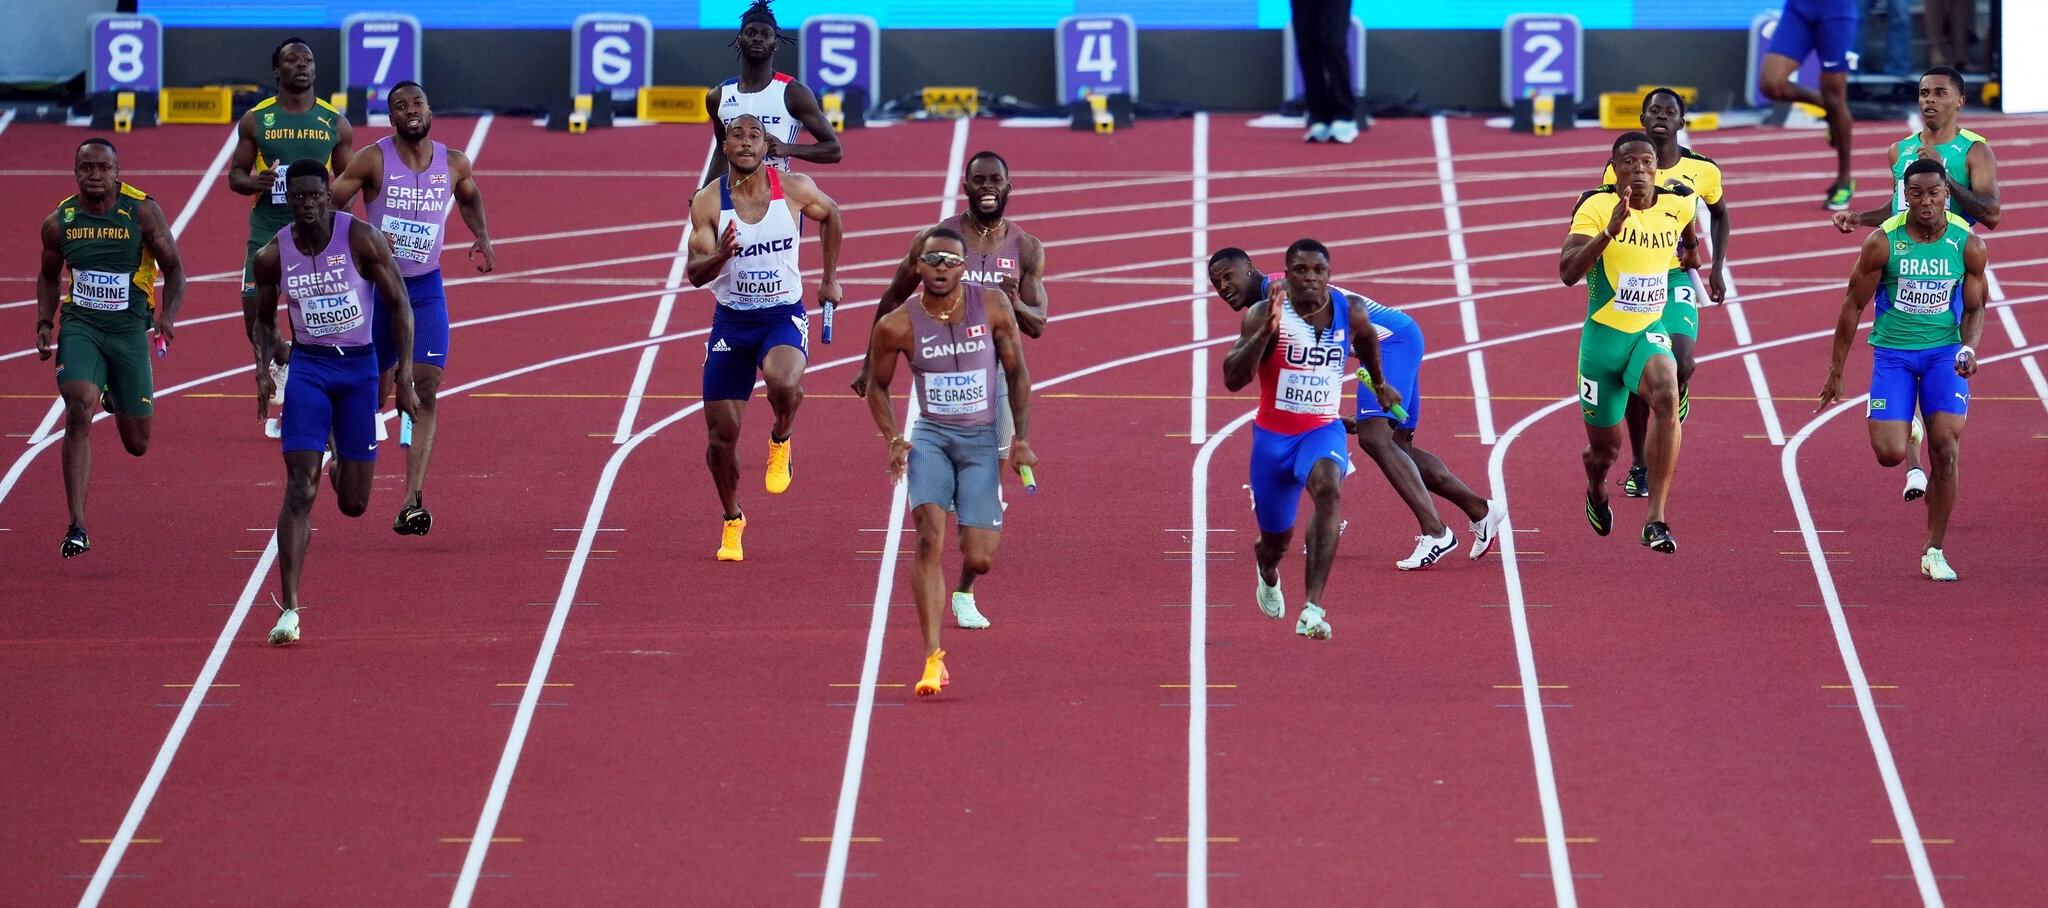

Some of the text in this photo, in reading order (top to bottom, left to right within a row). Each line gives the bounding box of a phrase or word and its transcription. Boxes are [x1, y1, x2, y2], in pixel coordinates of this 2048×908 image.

[107, 33, 144, 83] 8
[362, 36, 399, 84] 7
[592, 35, 632, 85] 6
[818, 37, 858, 86] 5
[1076, 34, 1117, 82] 4
[1523, 34, 1563, 83] 2
[264, 128, 331, 141] SOUTH AFRICA
[387, 185, 445, 200] GREAT
[386, 197, 444, 212] BRITAIN
[66, 227, 130, 239] SOUTH AFRICA
[400, 221, 431, 236] TDK
[733, 237, 793, 258] RANCE
[747, 269, 780, 280] TDK
[1899, 258, 1952, 276] BRASIL
[88, 273, 120, 285] TDK
[287, 268, 345, 288] GREAT
[959, 269, 1012, 283] ANAD
[1638, 275, 1664, 288] TDK
[76, 282, 126, 299] SIMBINE
[288, 281, 350, 299] BRITAIN
[736, 279, 783, 293] VICAUT
[1917, 280, 1948, 290] TDK
[316, 294, 351, 309] TDK
[739, 296, 780, 304] OREGON22
[1620, 288, 1666, 303] WALKER
[1681, 288, 1692, 303] 2
[1900, 288, 1948, 305] CARDOSO
[79, 300, 119, 310] OREGON22
[1903, 305, 1943, 314] OREGON22
[305, 305, 359, 325] PRESCOD
[313, 321, 356, 336] OREGON22
[921, 339, 987, 359] CANADA
[1286, 344, 1343, 367] USA
[943, 373, 977, 386] TDK
[1299, 374, 1331, 386] TDK
[929, 385, 984, 402] DE GRASSE
[1285, 386, 1330, 403] BRACY
[1583, 381, 1593, 401] 2
